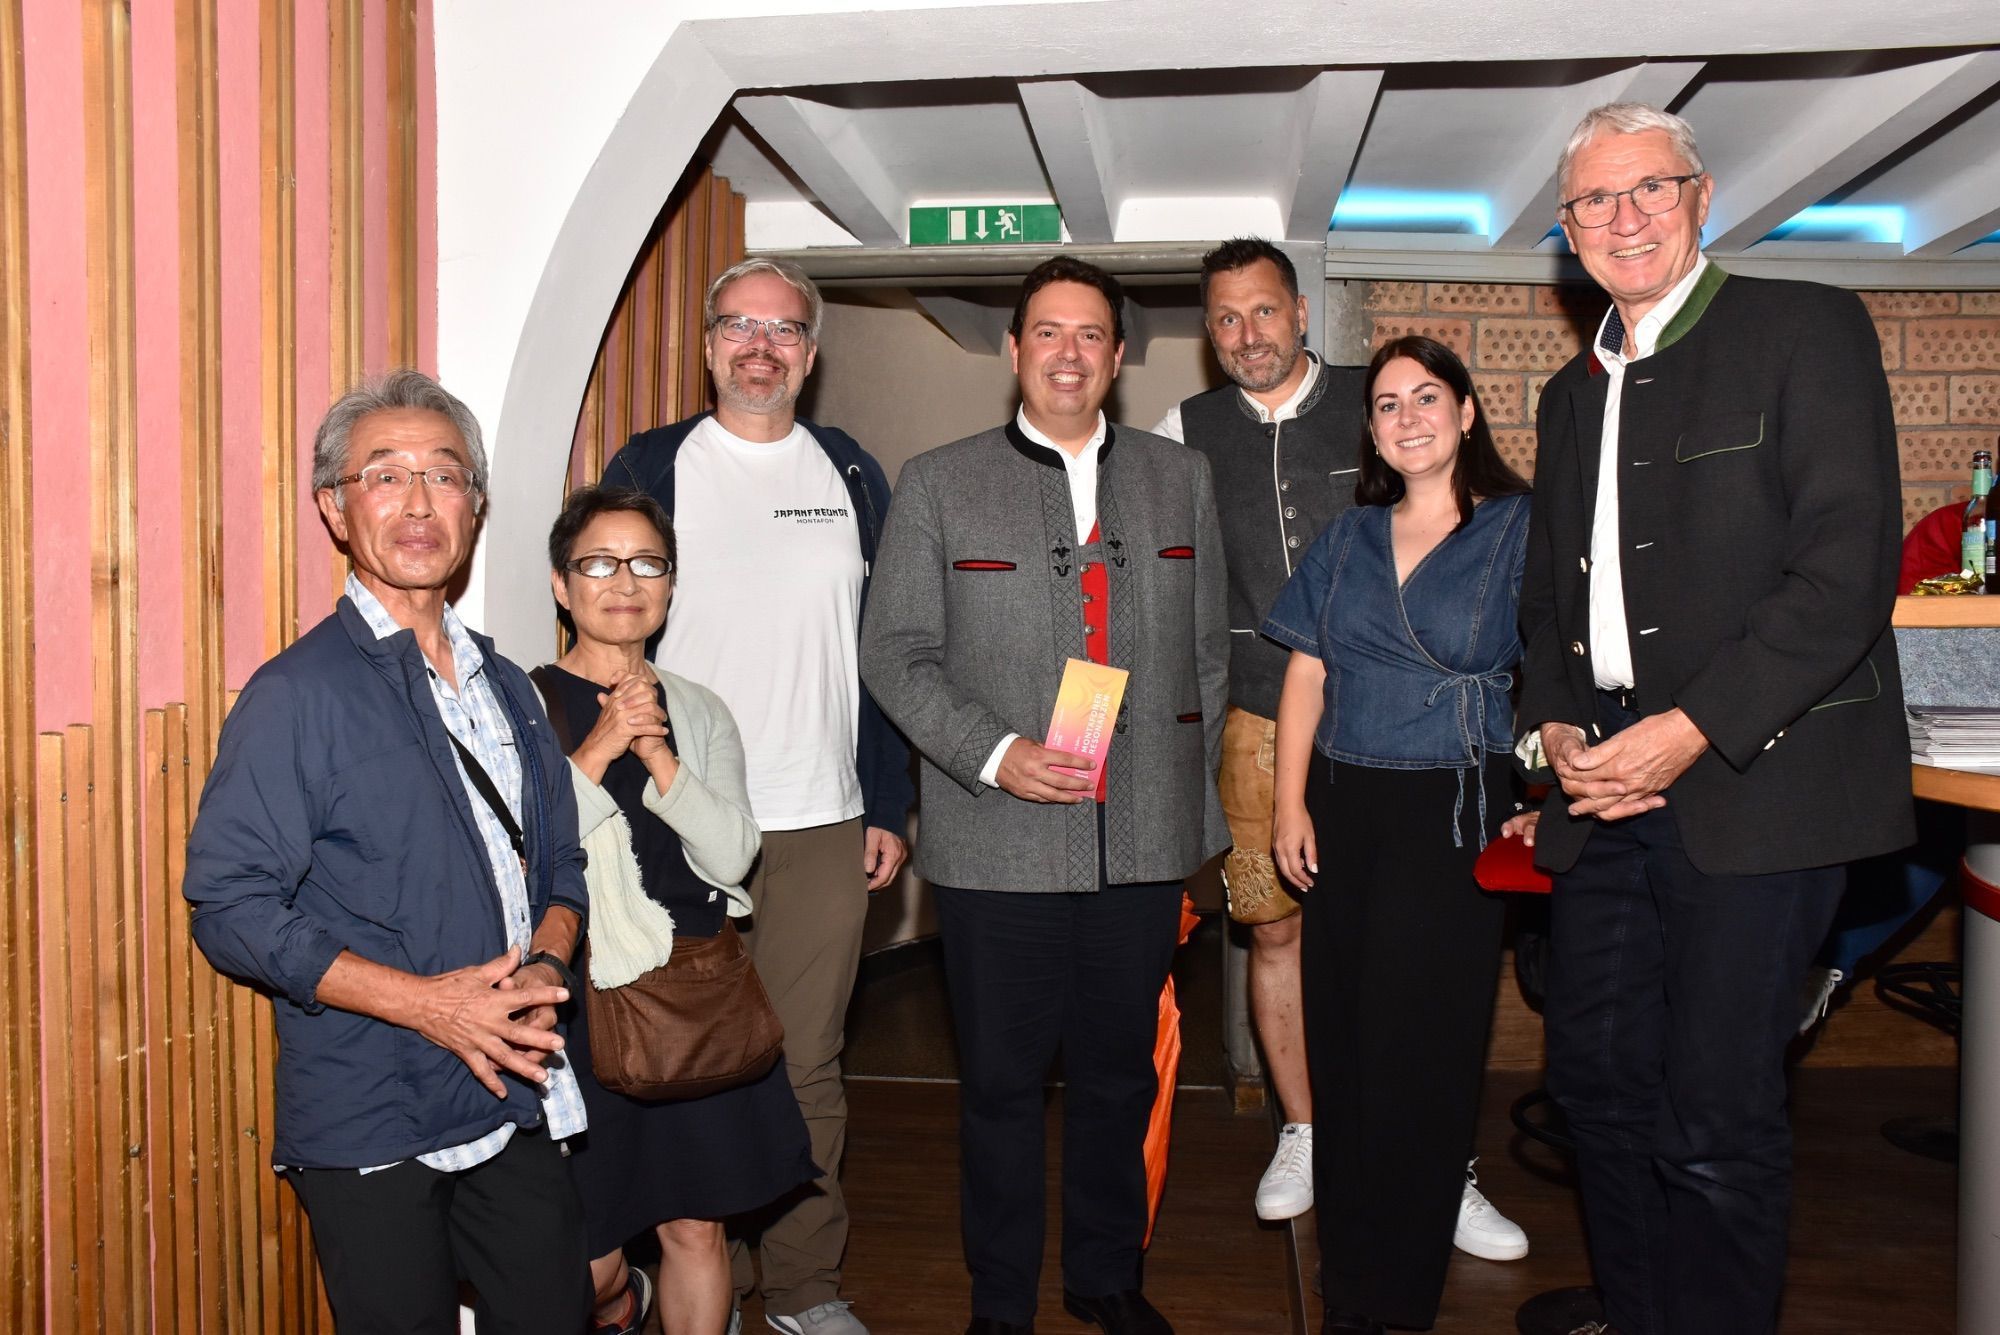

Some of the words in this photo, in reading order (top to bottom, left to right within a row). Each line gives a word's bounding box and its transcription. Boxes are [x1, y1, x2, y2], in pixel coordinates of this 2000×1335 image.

[774, 508, 849, 519] JAPANFREUNDE
[1081, 693, 1103, 753] MONTAFONER
[1088, 694, 1111, 755] RESONANZEN
